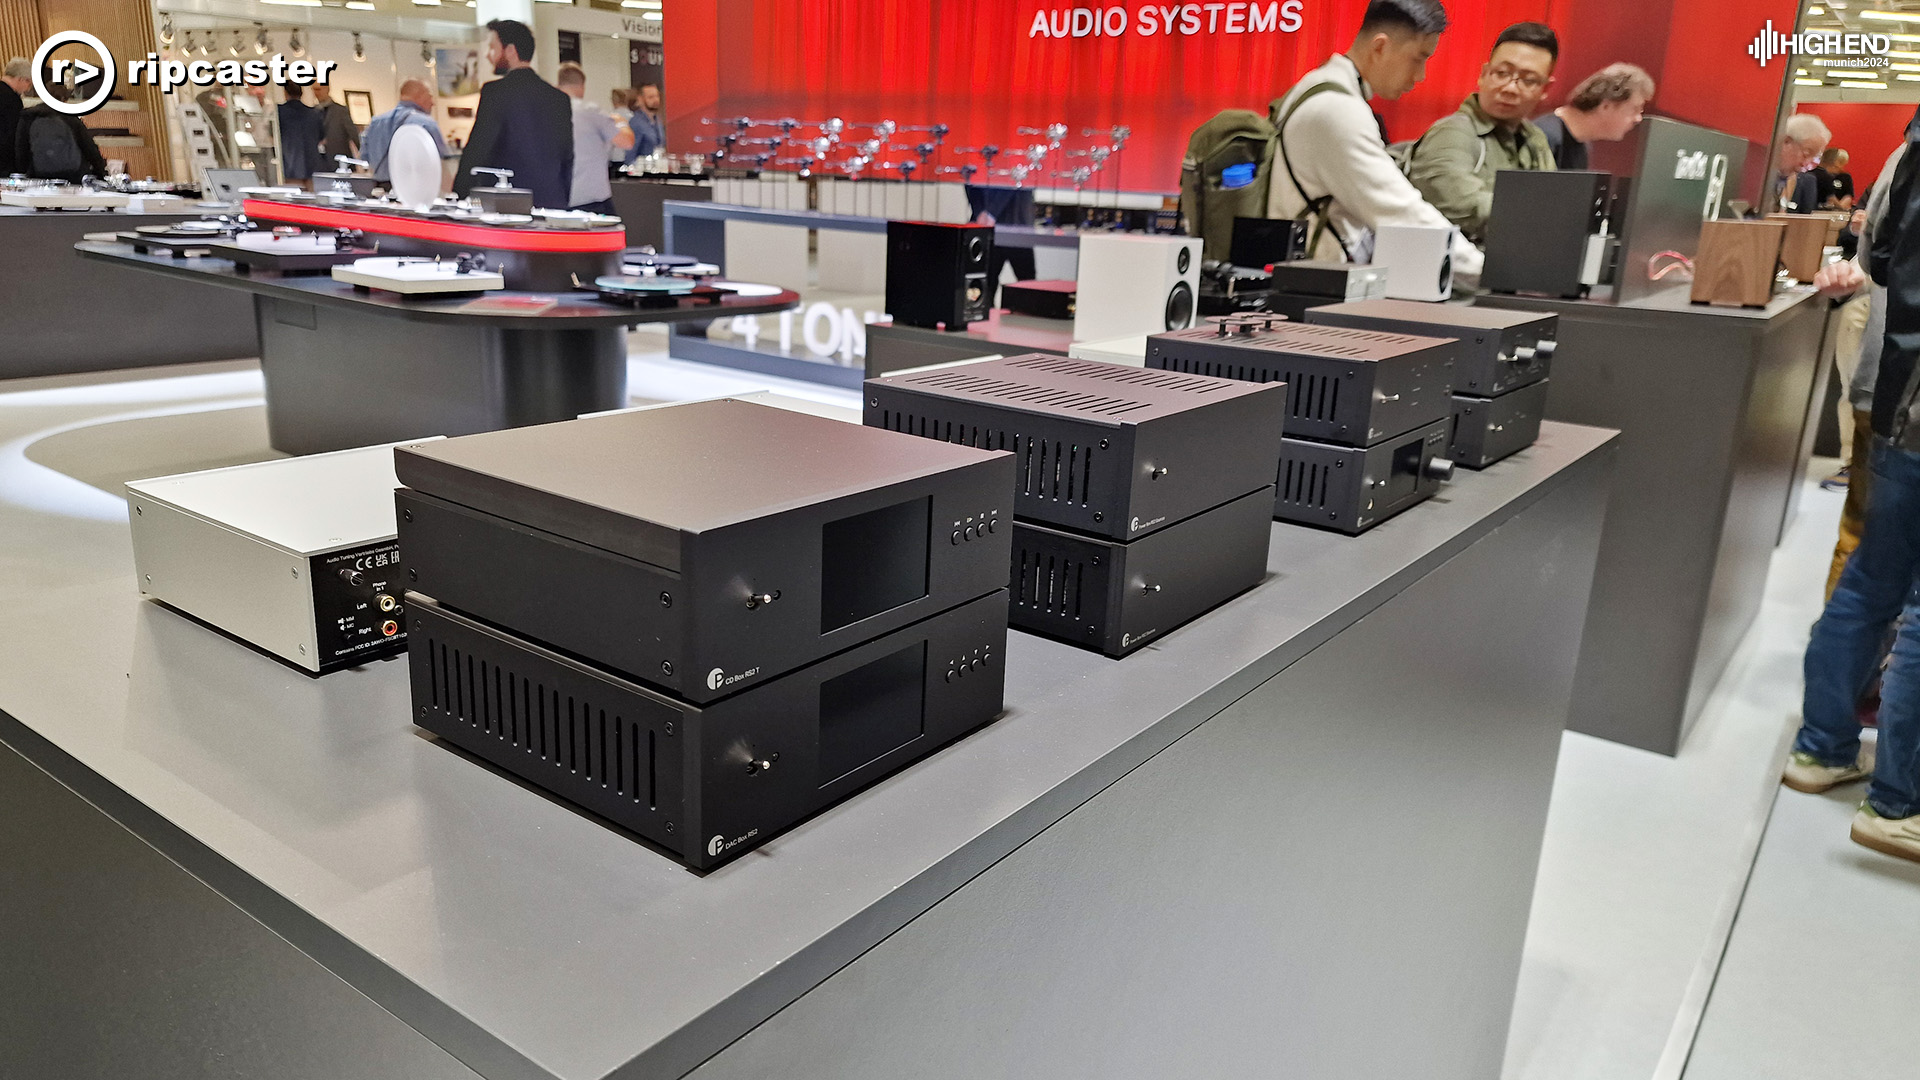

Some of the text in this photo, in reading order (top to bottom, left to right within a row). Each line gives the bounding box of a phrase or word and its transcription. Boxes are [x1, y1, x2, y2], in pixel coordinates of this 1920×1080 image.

[1029, 0, 1304, 39] AUDIO SYSTEMS
[356, 602, 368, 611] Left
[358, 626, 372, 635] Right
[734, 674, 745, 682] Box
[744, 669, 756, 678] RS2
[725, 839, 738, 850] DAC
[737, 835, 748, 844] Box
[747, 828, 758, 838] RS2
